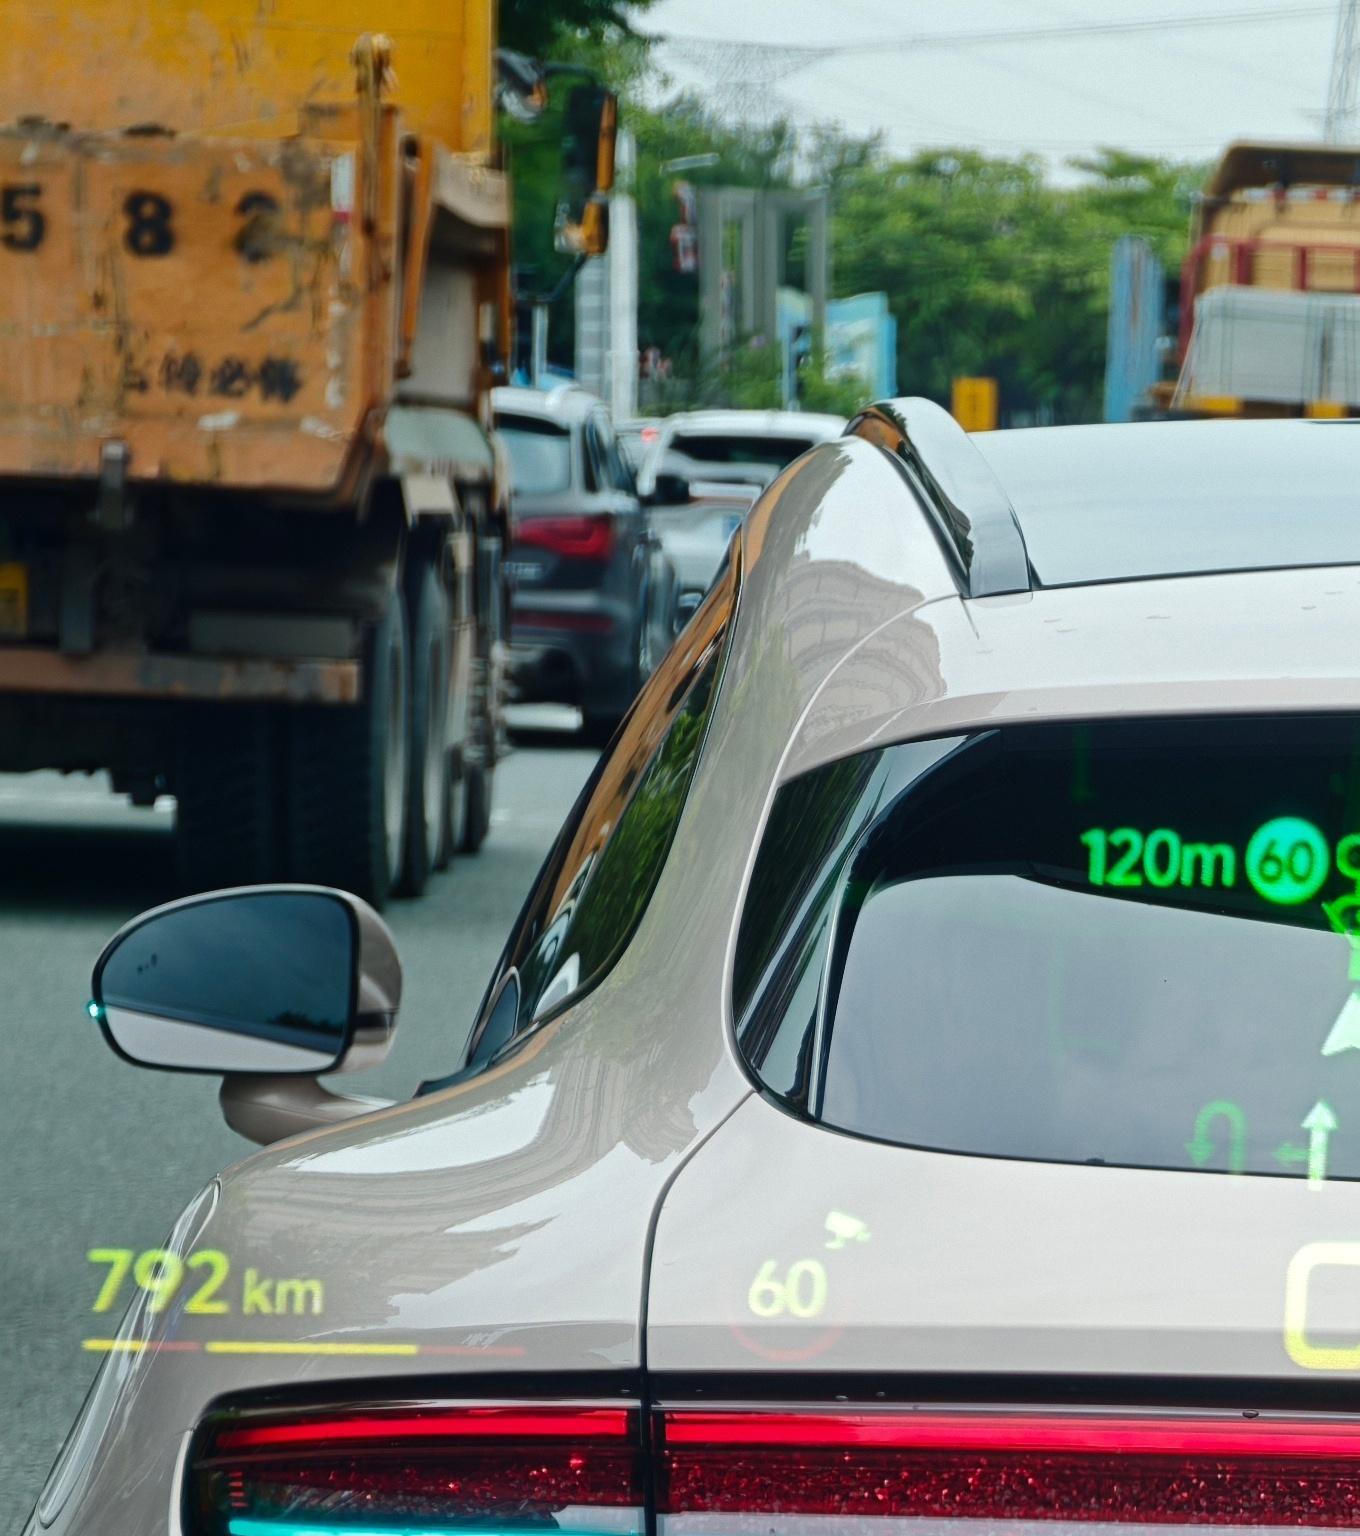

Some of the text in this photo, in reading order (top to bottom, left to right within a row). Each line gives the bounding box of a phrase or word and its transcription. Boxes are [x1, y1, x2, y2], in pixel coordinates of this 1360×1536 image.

[1080, 827, 1316, 888] 120m 60
[87, 1248, 322, 1316] 792 km
[748, 1259, 828, 1318] 60
